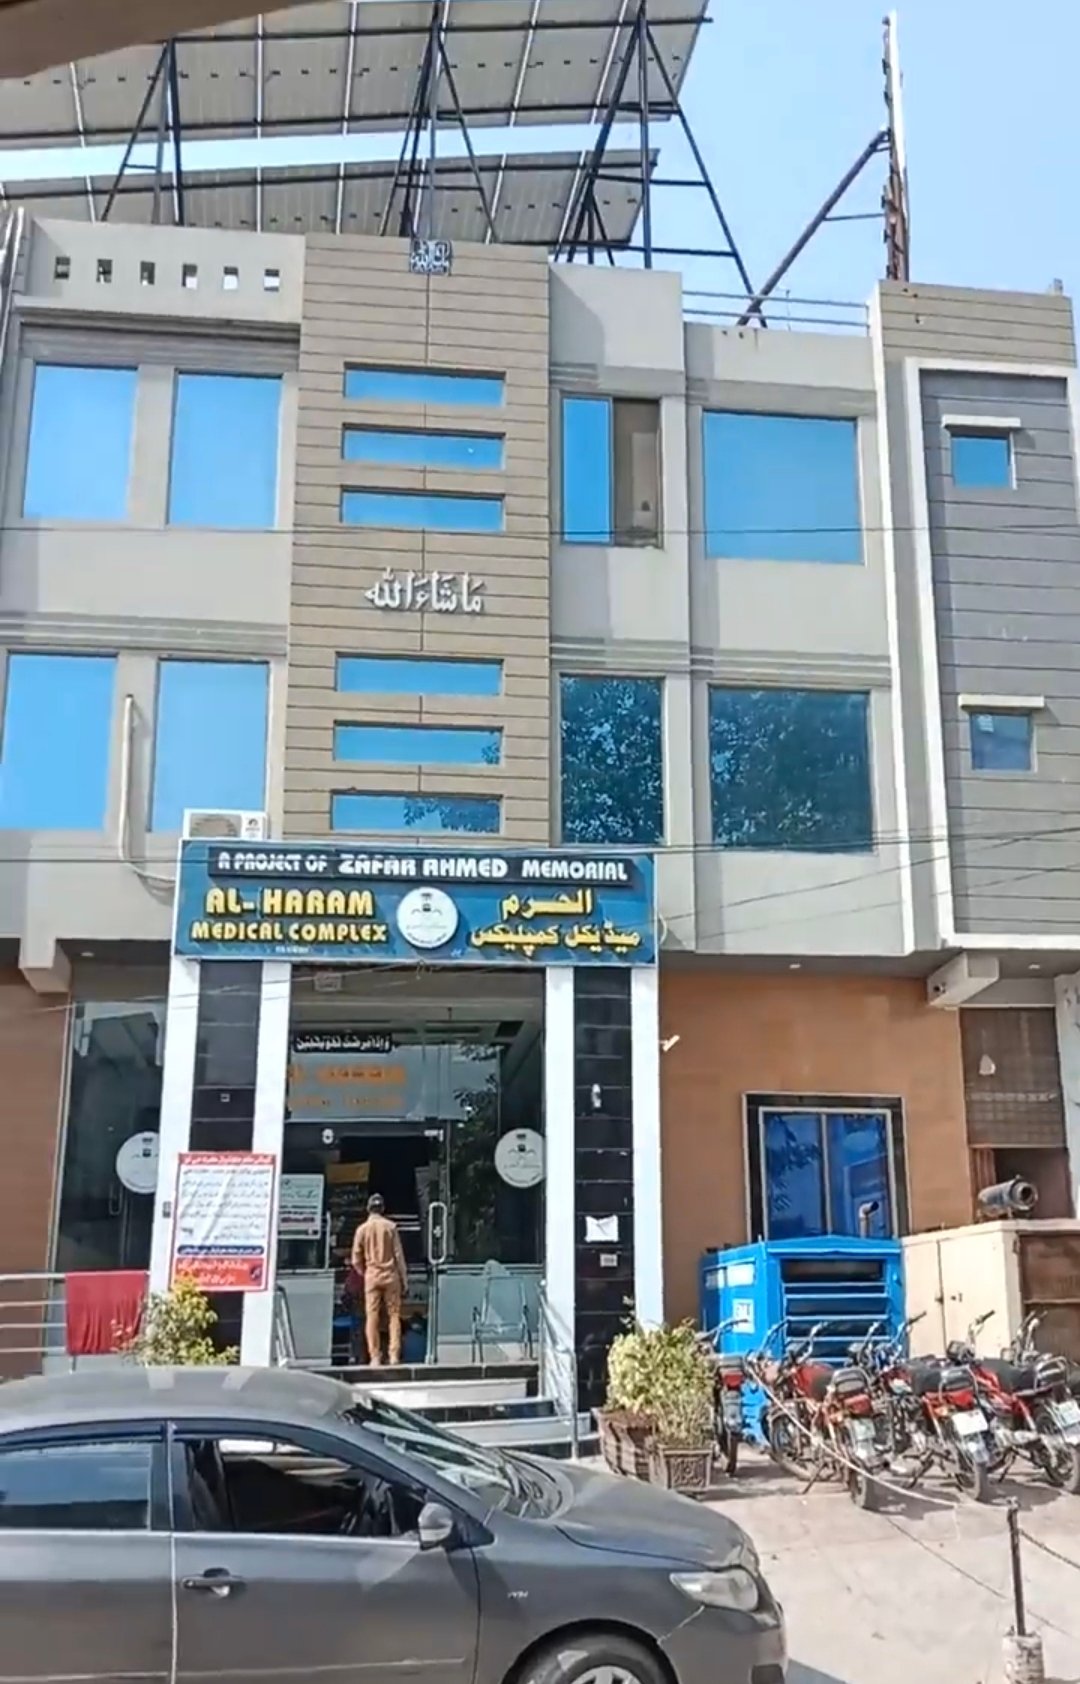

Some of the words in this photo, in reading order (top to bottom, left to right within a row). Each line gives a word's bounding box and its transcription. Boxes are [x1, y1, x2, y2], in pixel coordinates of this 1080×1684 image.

[218, 851, 231, 869] A
[234, 853, 301, 872] PROJECT
[305, 854, 328, 873] OF
[338, 853, 417, 876] ZAFAR
[423, 857, 508, 878] AHMED
[521, 859, 628, 881] MEMORIAL
[502, 887, 593, 920] الحرم
[191, 920, 284, 941] MEDICAL
[288, 922, 388, 942] COMPLEX
